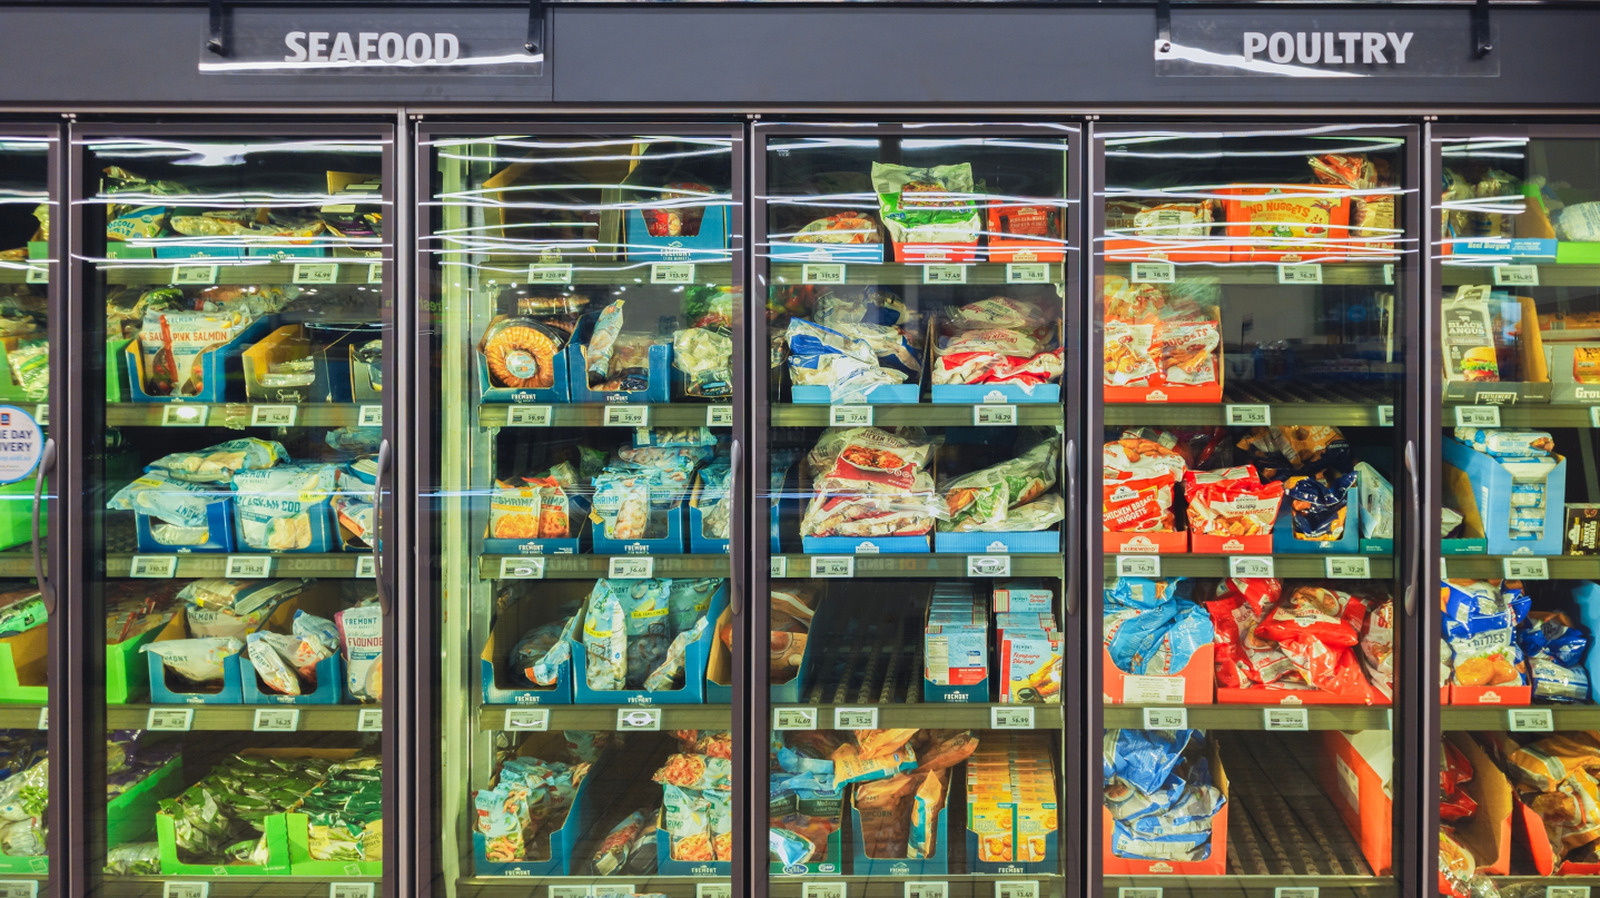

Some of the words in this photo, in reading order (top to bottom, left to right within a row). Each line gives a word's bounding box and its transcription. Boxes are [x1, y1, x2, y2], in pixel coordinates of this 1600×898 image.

[285, 31, 460, 63] SEAFOOD
[1243, 31, 1414, 64] POULTRY
[1266, 201, 1310, 218] NUGGETS
[1447, 322, 1483, 330] BLACK
[173, 331, 191, 341] PINK
[193, 331, 228, 341] SALMON
[11, 430, 33, 439] DAY
[593, 495, 619, 505] SHRIMP
[281, 501, 301, 513] COD
[1117, 508, 1149, 524] NUGGETS
[345, 617, 377, 626] FREMONT
